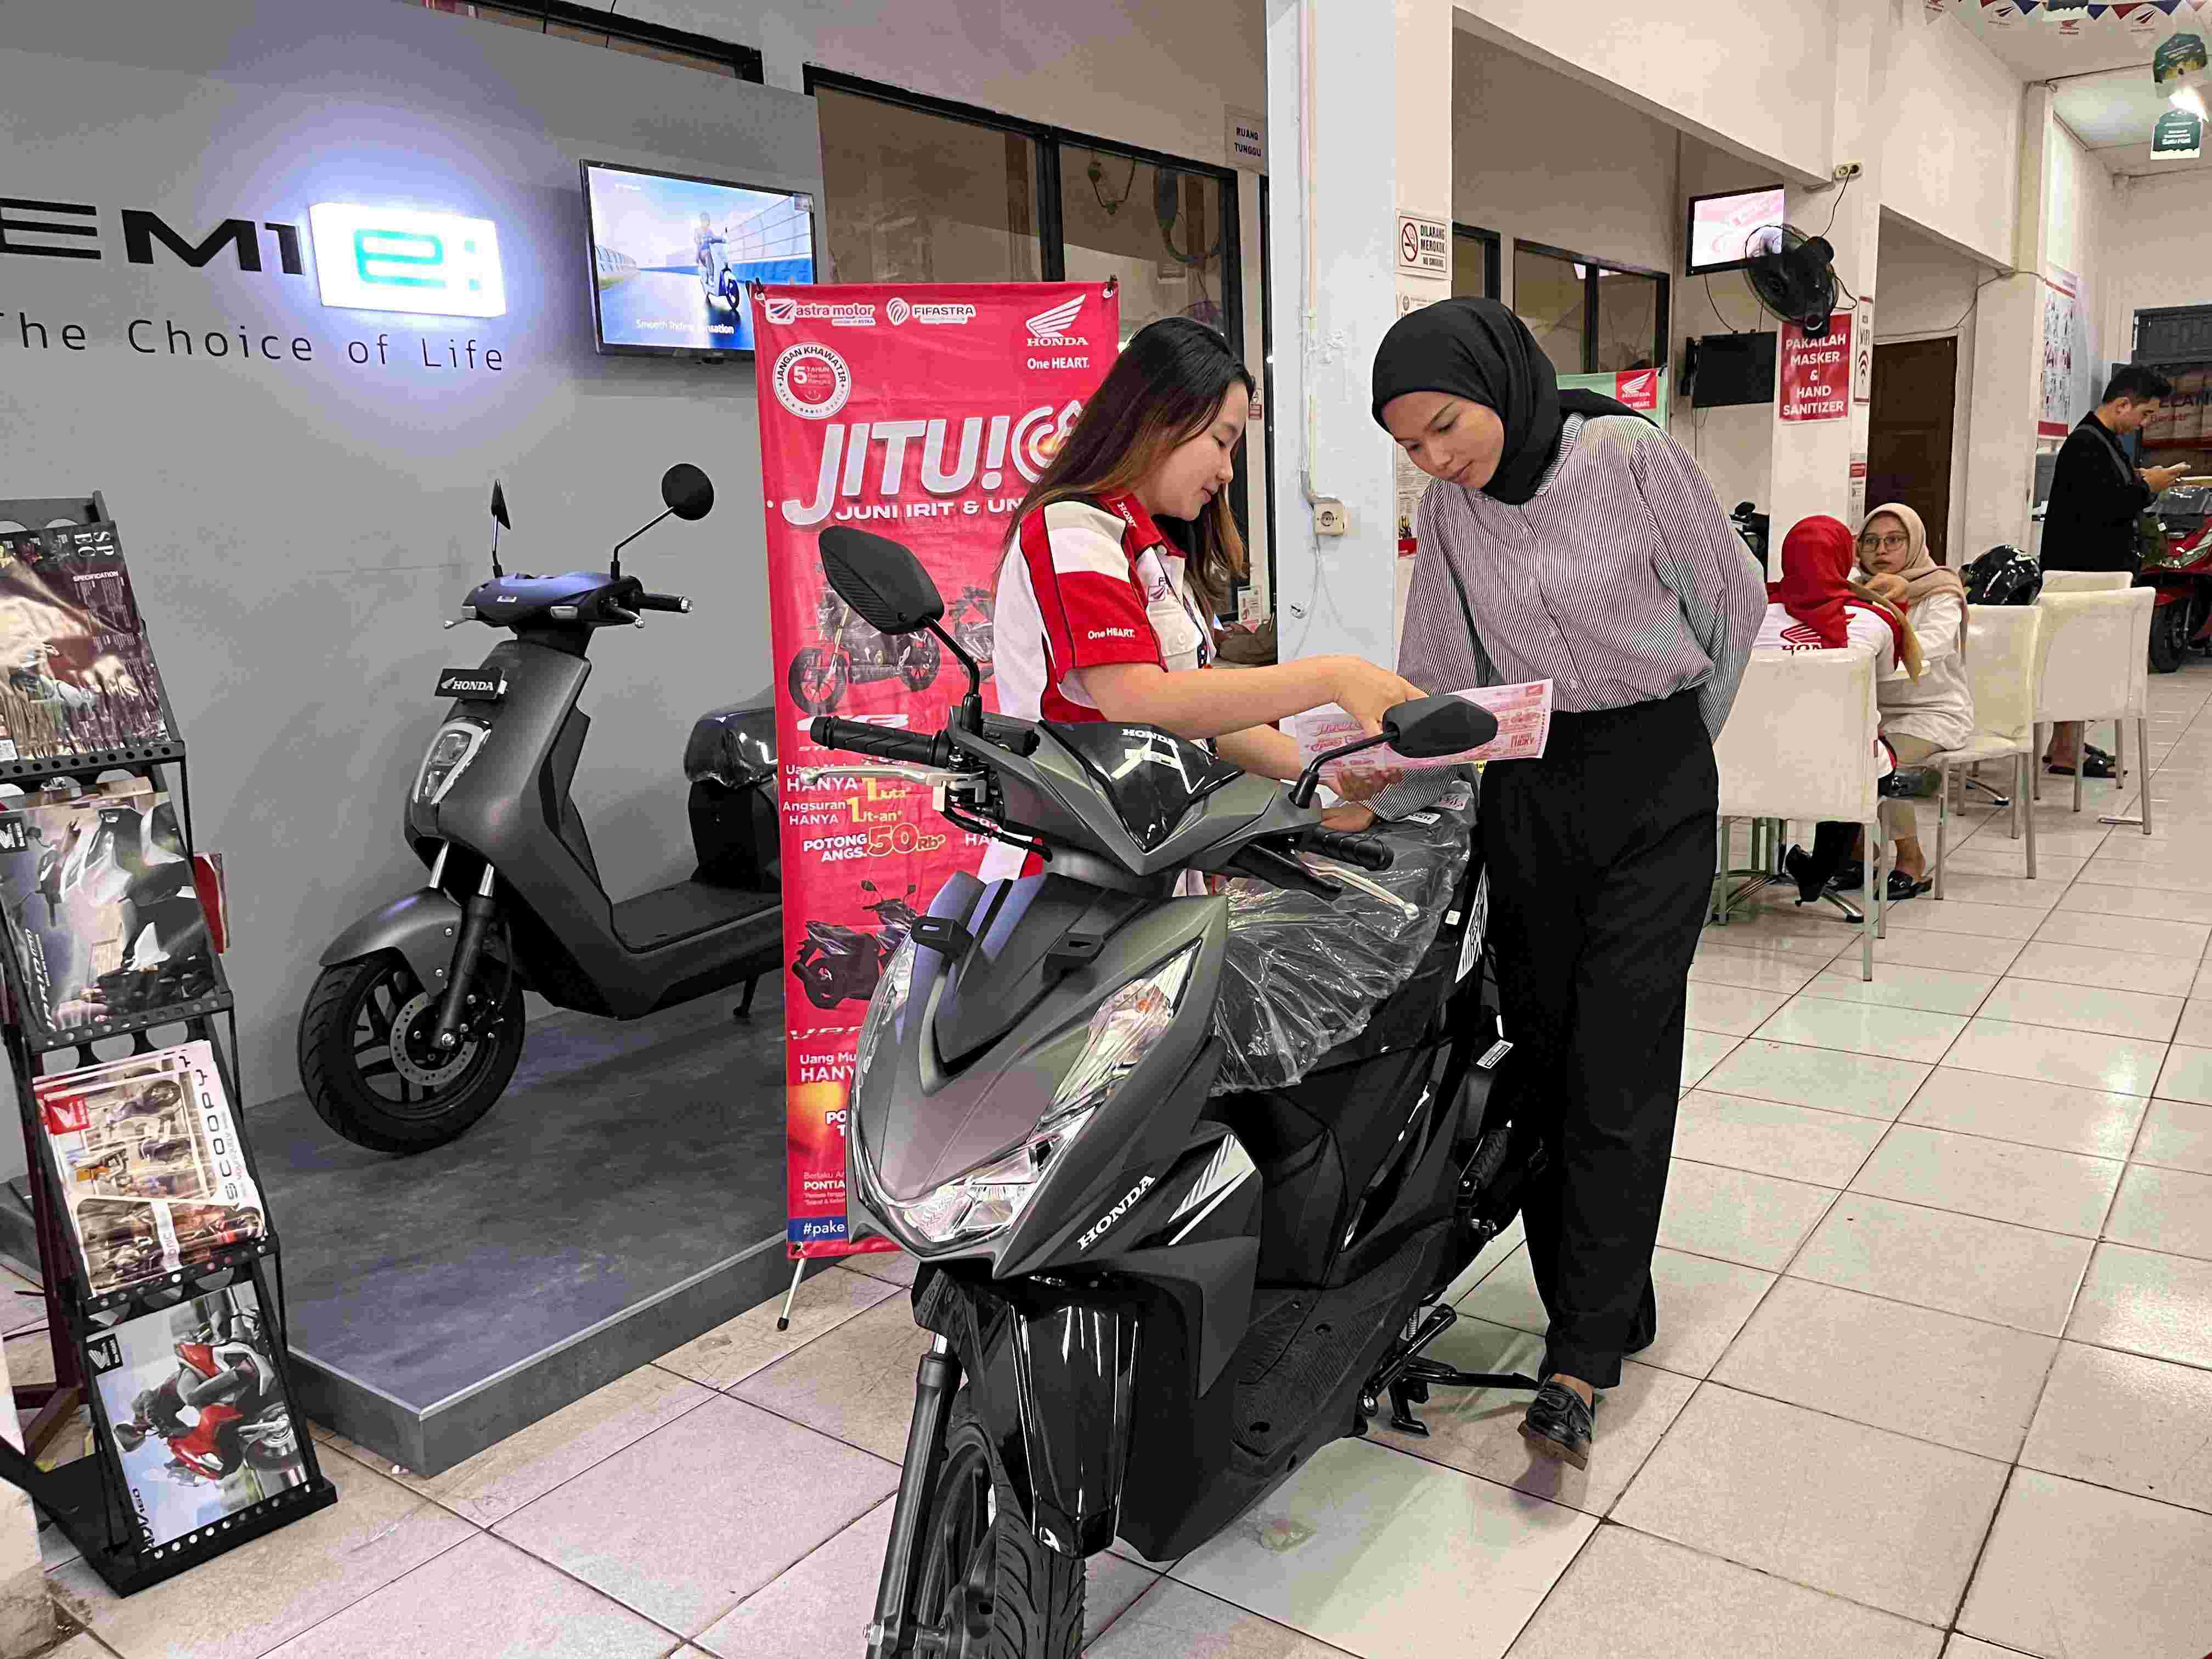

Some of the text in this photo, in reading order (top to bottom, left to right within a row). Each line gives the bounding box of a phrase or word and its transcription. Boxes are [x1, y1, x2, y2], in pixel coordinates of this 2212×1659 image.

[1236, 127, 1259, 140] RUANG
[1234, 142, 1261, 156] TUNGGU
[1420, 225, 1444, 240] DILARANG
[1420, 239, 1445, 254] MEROKOK
[797, 304, 874, 316] astra motor
[914, 306, 974, 316] FIFASTRA
[128, 318, 313, 362] Choice
[347, 334, 389, 365] of
[421, 337, 504, 372] Life
[1026, 337, 1089, 347] HONDA
[1785, 333, 1846, 351] PAKAILAH
[776, 346, 847, 382] JANGAN KHAWATIR
[1027, 357, 1049, 369] One
[1790, 351, 1841, 366] MASKER
[793, 365, 808, 384] 5
[1809, 369, 1819, 381] &
[1796, 385, 1832, 399] HAND
[1782, 400, 1844, 416] SANITIZER
[781, 415, 1011, 526] JITU!
[835, 501, 898, 521] JUNI
[906, 501, 954, 519] IRIT
[963, 501, 979, 515] &
[1087, 630, 1106, 640] One
[452, 680, 494, 691] HONDA
[1121, 729, 1179, 749] HONDA
[782, 801, 847, 814] Angsuran
[789, 814, 839, 826] HANYA
[803, 833, 868, 852] POTONG
[821, 847, 868, 862] ANGS.
[799, 1053, 835, 1066] Uang
[800, 1065, 856, 1083] HANY
[803, 1180, 845, 1191] PONTIA
[1076, 1173, 1155, 1251] HONDA
[803, 1219, 845, 1238] #pake
